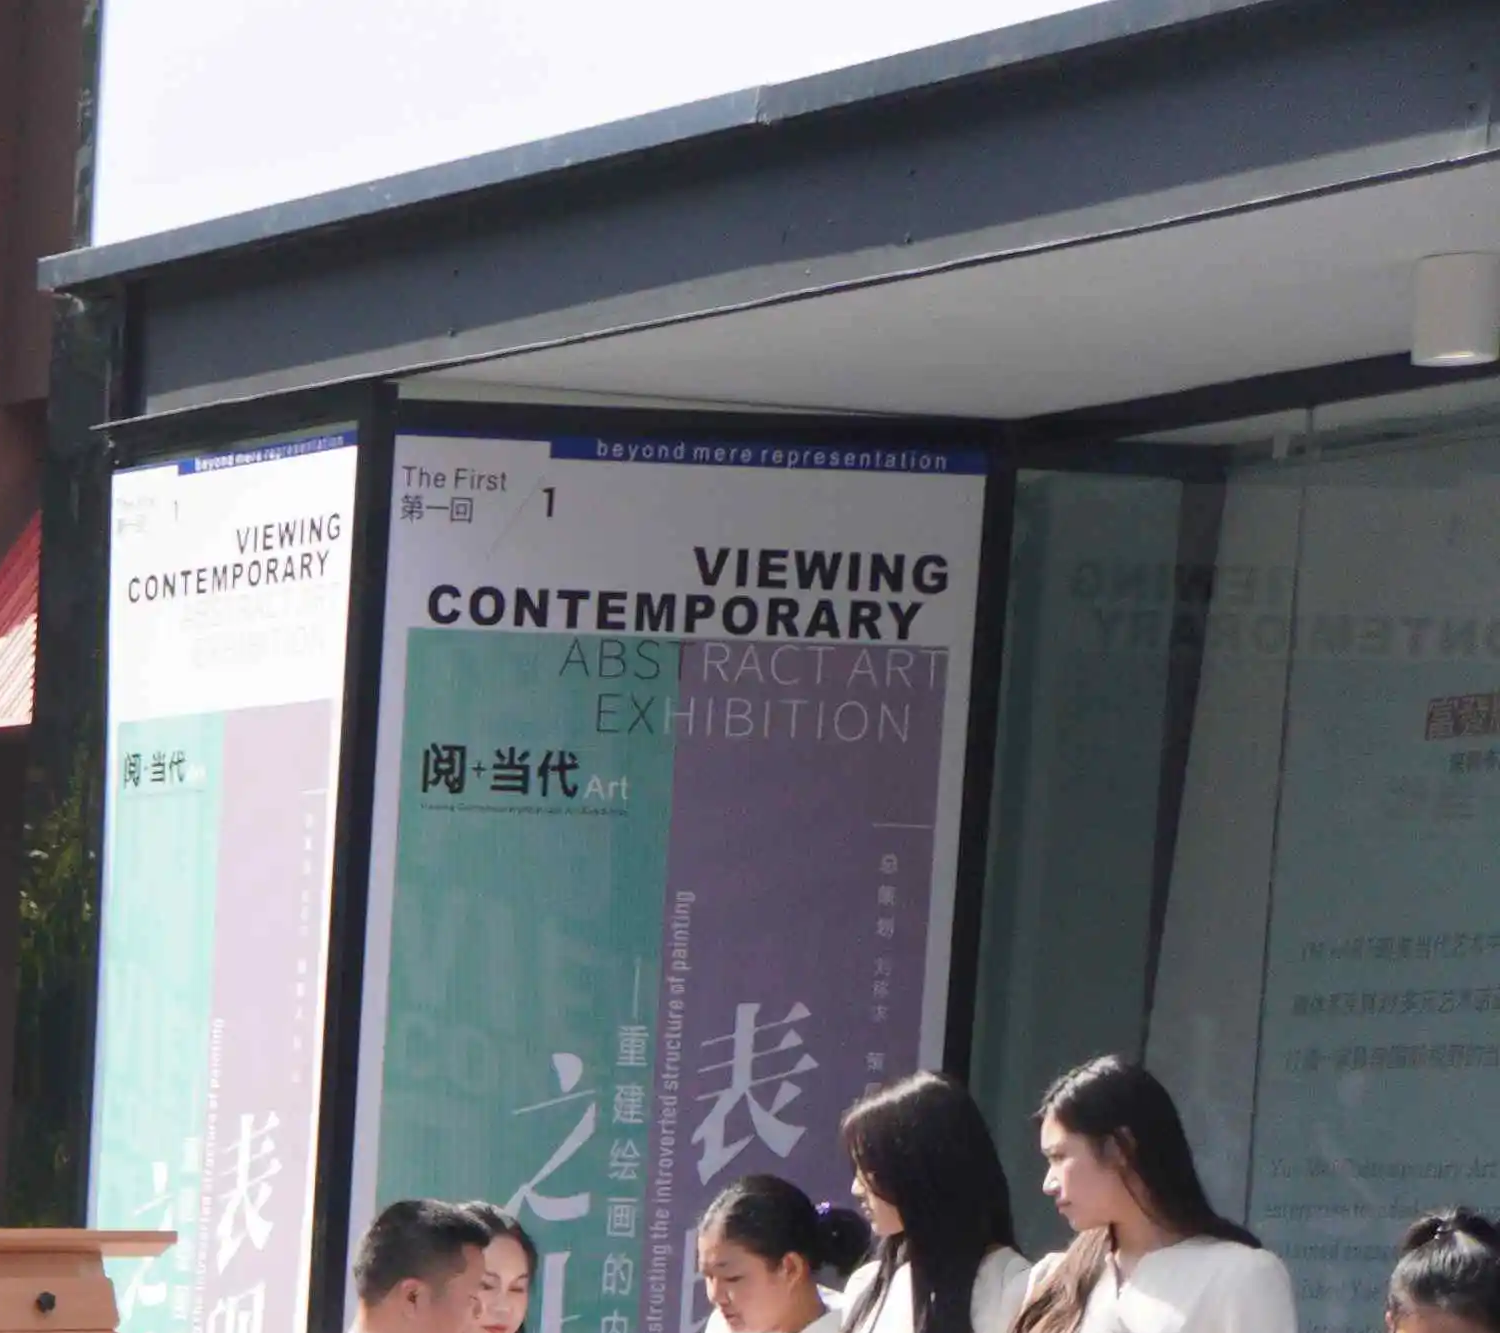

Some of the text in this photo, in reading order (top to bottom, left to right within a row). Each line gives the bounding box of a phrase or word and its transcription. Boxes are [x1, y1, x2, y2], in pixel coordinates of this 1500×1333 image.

[596, 438, 948, 471] beyond mere representation
[401, 465, 508, 492] The First
[400, 493, 474, 524] 第一回
[540, 486, 556, 518] 1
[236, 512, 342, 555] VIEWING
[128, 550, 330, 604] CONTEMPORARY
[692, 545, 950, 595] VIEWING
[427, 584, 924, 641] CONTEMPORARY
[558, 637, 951, 689] ABSTRACT ART
[596, 692, 911, 744] EXHIBITION
[583, 773, 630, 801] Art
[671, 890, 697, 971] painting
[668, 974, 687, 997] of
[663, 999, 686, 1092] structure
[656, 1095, 679, 1203] introverted
[650, 1208, 672, 1240] the
